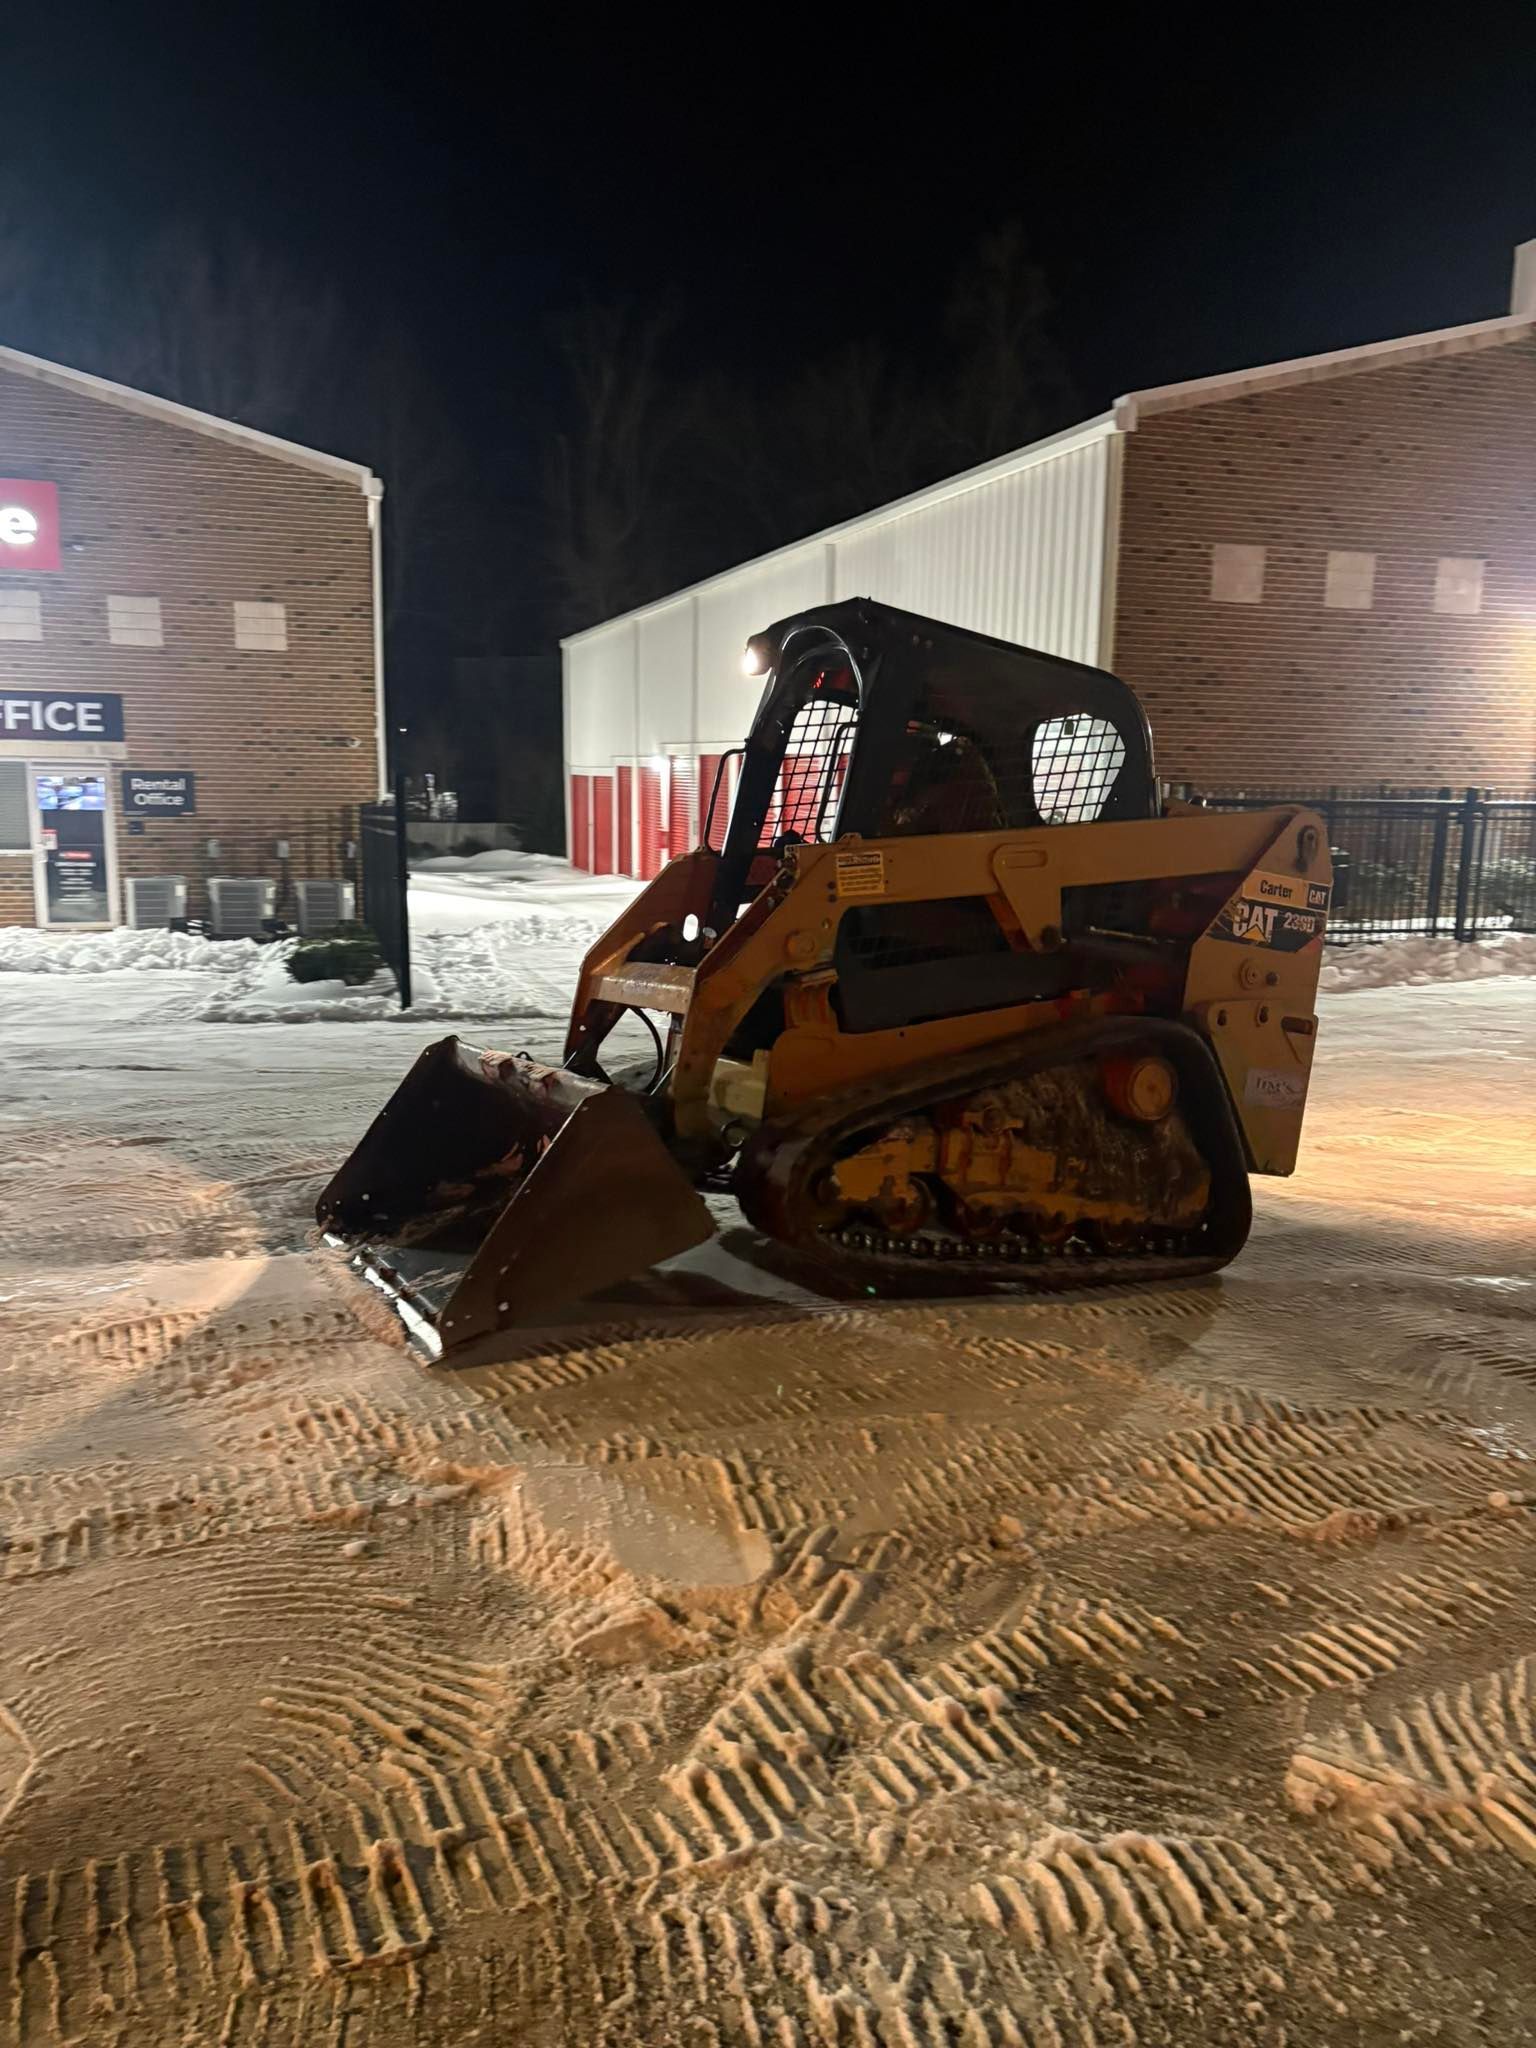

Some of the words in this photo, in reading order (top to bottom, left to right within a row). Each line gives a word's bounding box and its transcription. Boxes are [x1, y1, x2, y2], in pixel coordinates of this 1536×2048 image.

[0, 700, 105, 732] FICE
[130, 778, 186, 790] Rental
[134, 793, 185, 806] Office
[1259, 879, 1293, 899] Carter
[1308, 889, 1327, 905] CAT
[1232, 901, 1279, 943] CAT
